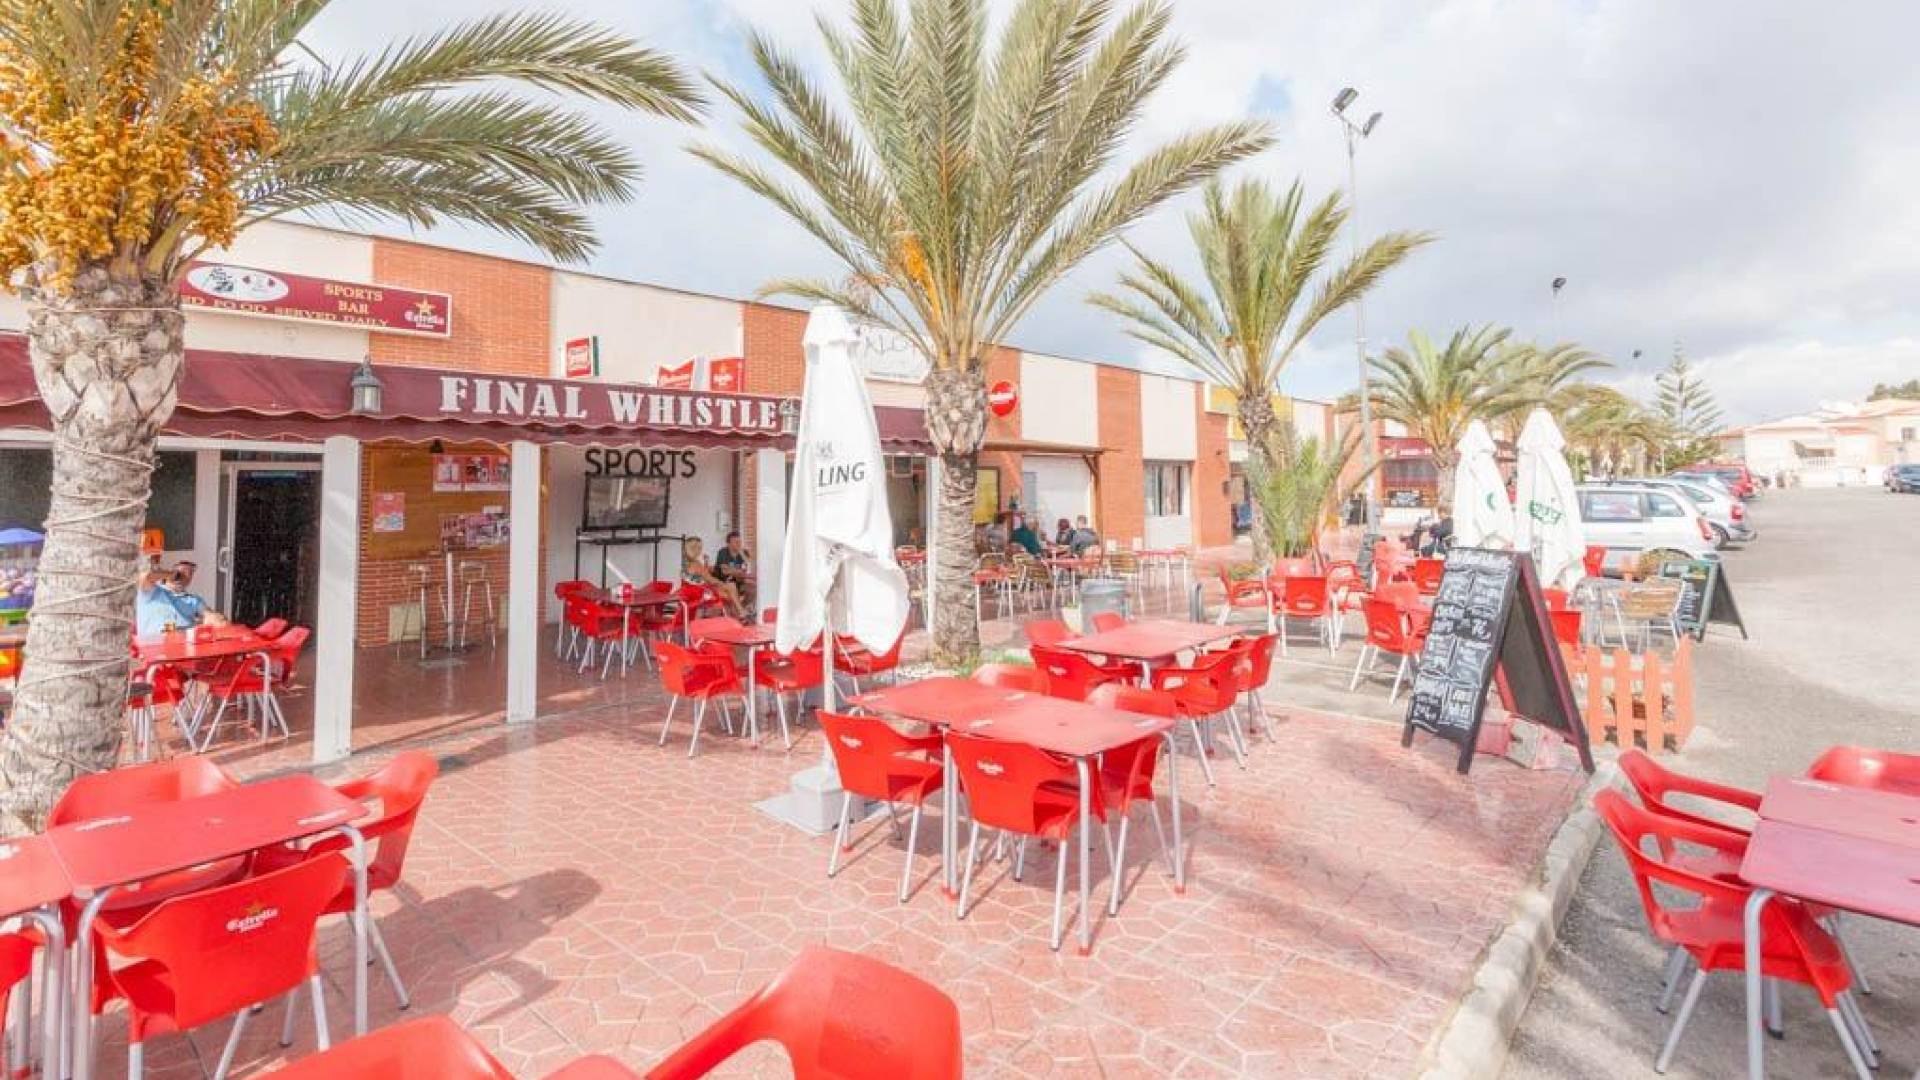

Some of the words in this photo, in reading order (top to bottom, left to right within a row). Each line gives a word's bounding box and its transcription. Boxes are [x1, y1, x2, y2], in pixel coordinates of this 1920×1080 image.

[324, 284, 383, 301] SPORTS
[274, 307, 336, 320] SERVED
[343, 314, 388, 327] DAILY
[338, 300, 368, 314] BAR
[439, 376, 588, 419] FINAL
[607, 389, 777, 430] WHISTLE
[584, 449, 697, 479] SPORTS
